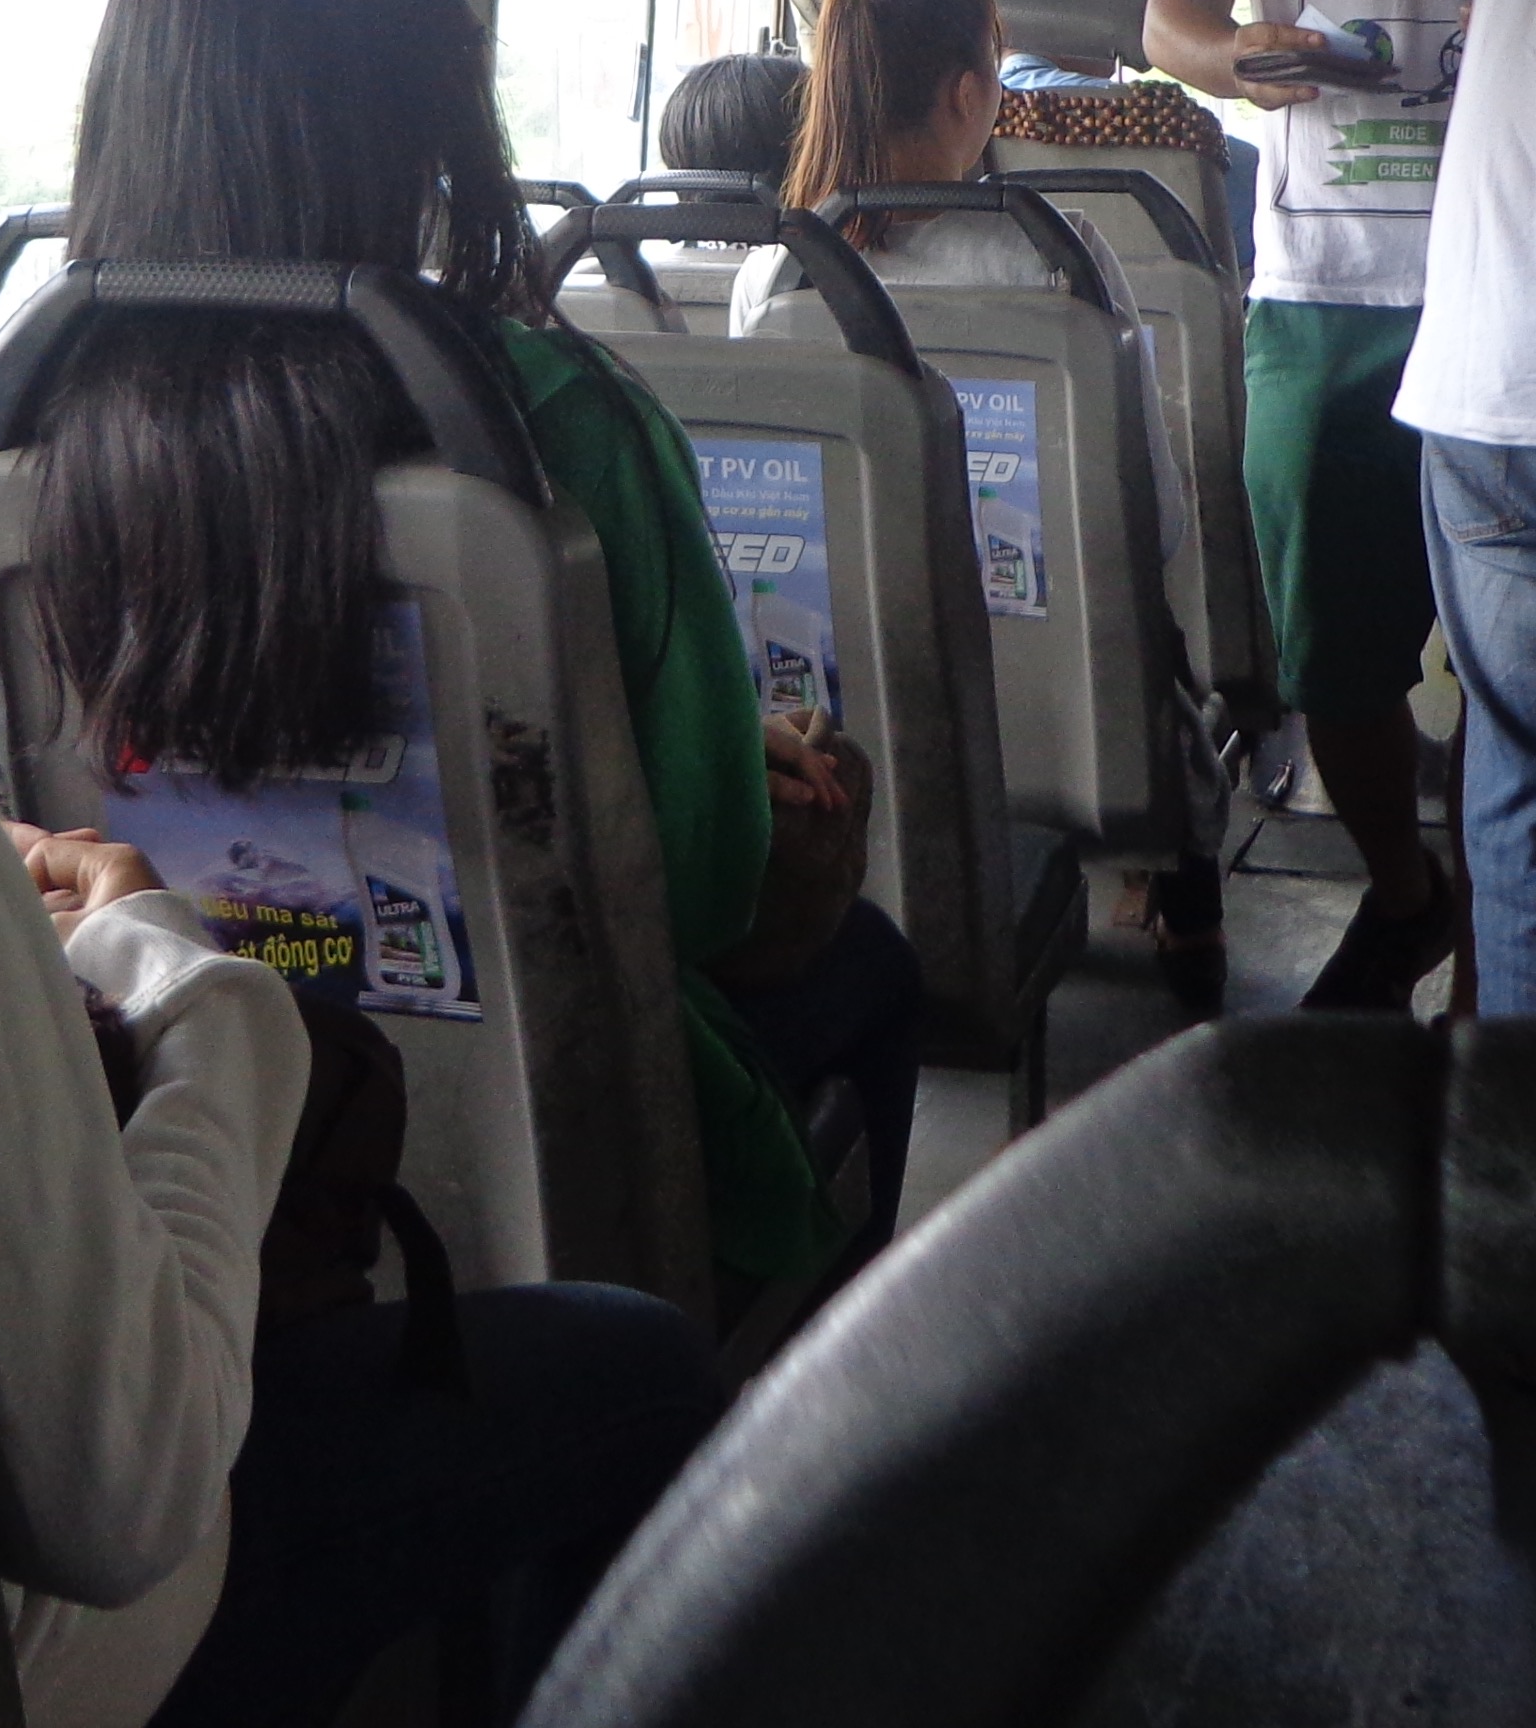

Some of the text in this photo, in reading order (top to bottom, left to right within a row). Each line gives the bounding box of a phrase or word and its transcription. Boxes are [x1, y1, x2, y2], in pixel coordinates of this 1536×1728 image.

[1389, 125, 1427, 141] RIDE
[1378, 162, 1433, 179] GREEN
[956, 392, 1024, 412] PV OIL
[721, 457, 756, 479] PV
[763, 458, 808, 482] OIL
[257, 904, 293, 923] ma
[301, 911, 338, 930] sát
[377, 900, 420, 917] ULTRA
[265, 932, 318, 976] động
[324, 935, 354, 966] cơ
